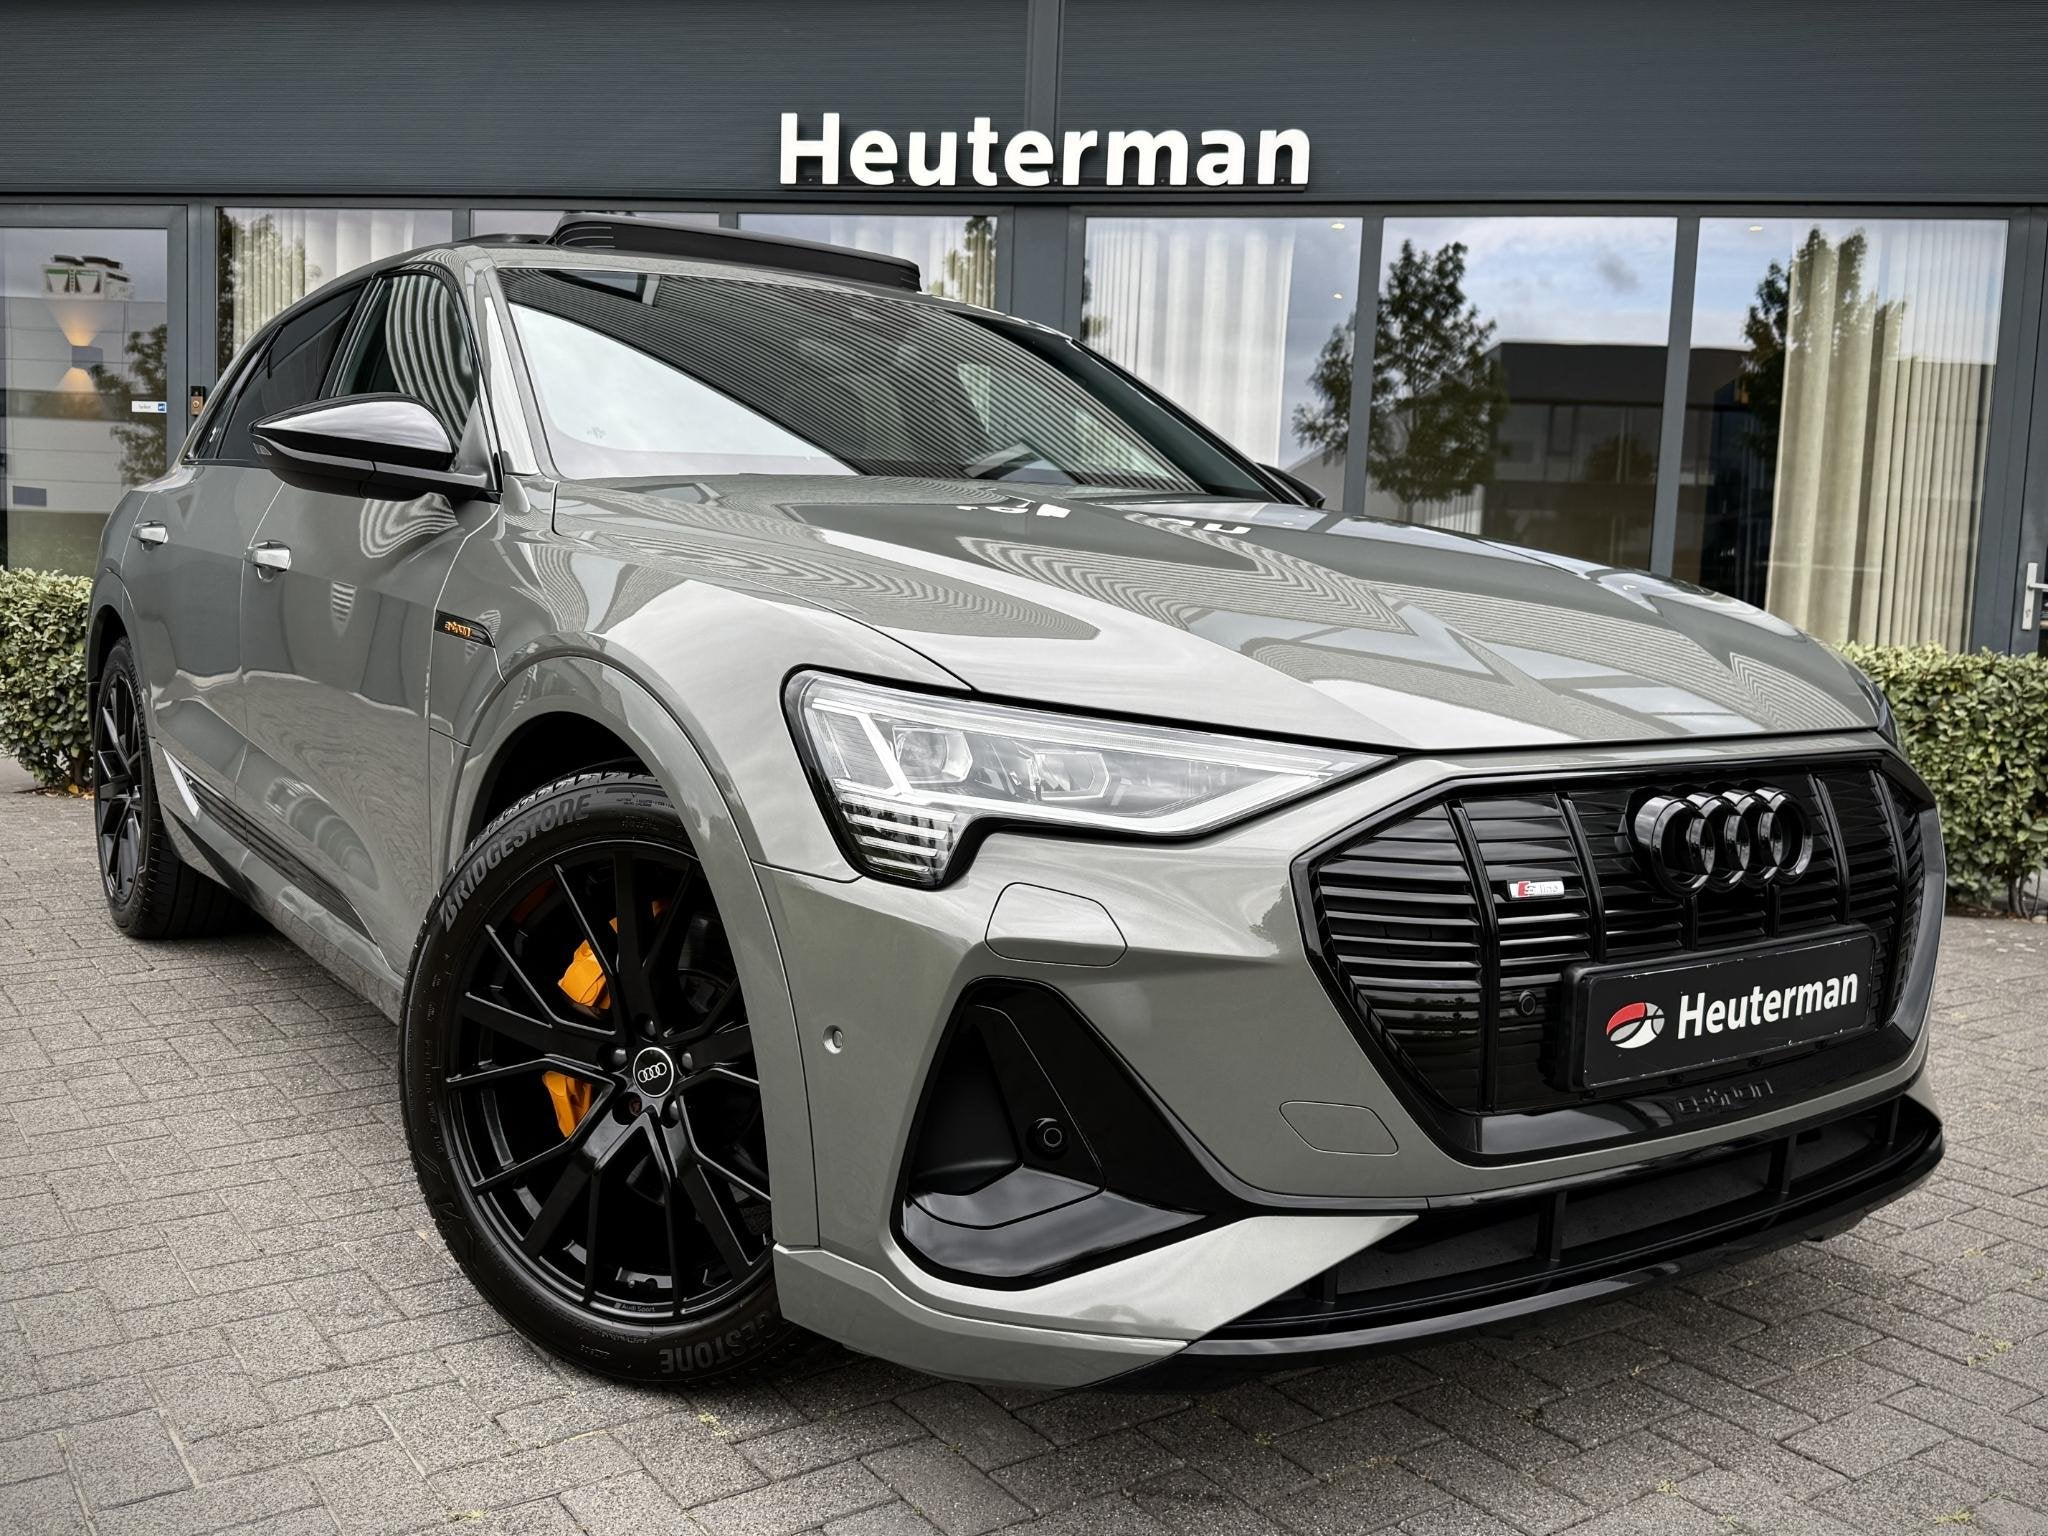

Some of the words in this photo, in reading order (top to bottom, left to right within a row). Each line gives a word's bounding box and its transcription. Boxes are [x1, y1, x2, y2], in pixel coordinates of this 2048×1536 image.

[780, 111, 1311, 187] Heuterman
[437, 793, 593, 933] BRIDGESTONE
[1677, 972, 1858, 1040] Heuterman
[657, 1311, 778, 1375] GESTONE
